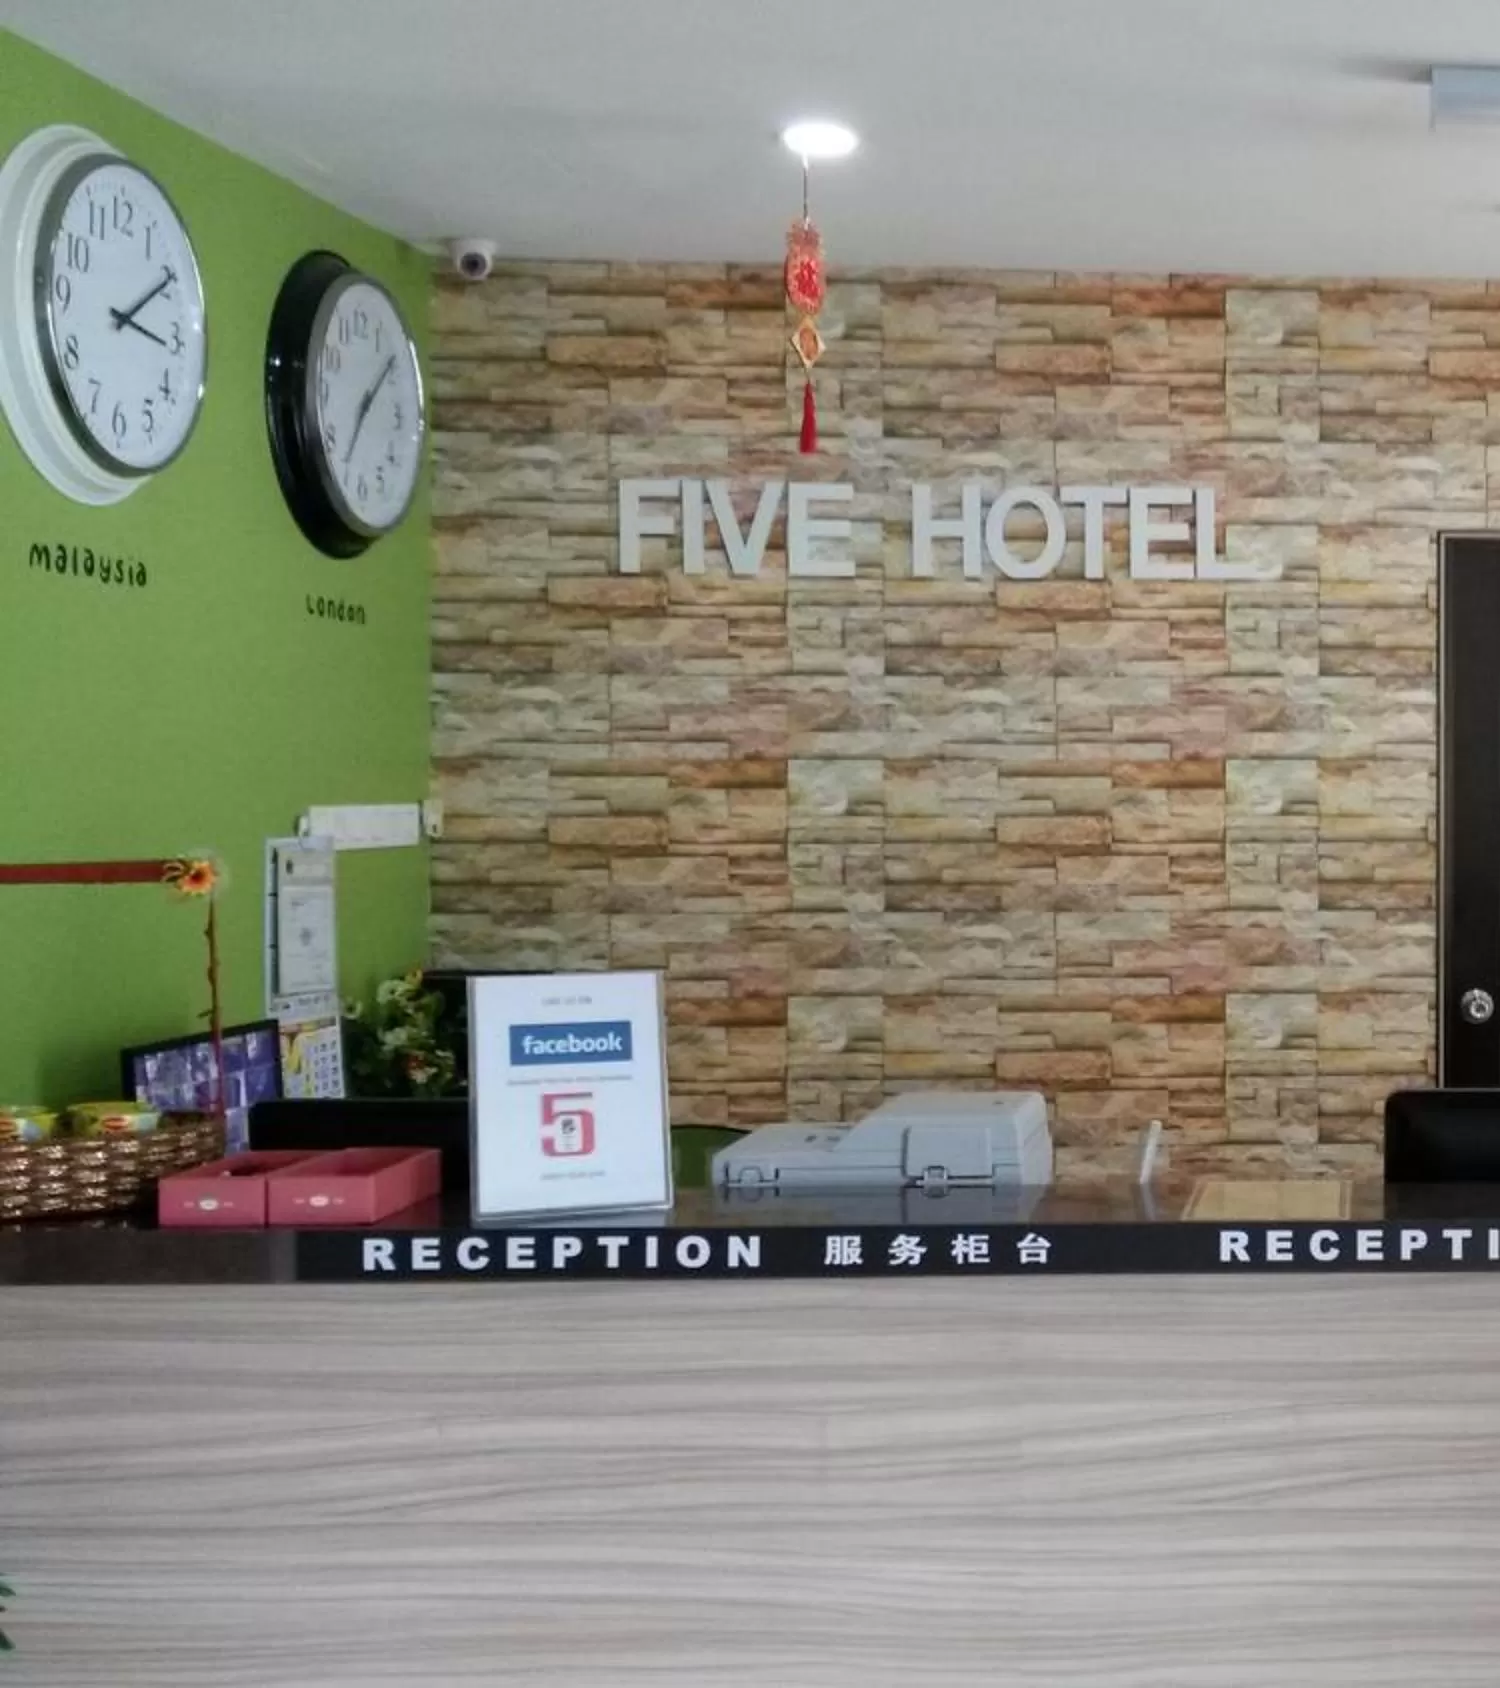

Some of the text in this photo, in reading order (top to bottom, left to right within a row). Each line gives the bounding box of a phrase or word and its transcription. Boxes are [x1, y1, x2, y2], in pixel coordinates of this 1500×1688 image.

[89, 199, 105, 240] 11
[112, 196, 134, 237] 12
[67, 231, 89, 273] 10
[144, 225, 152, 260] 1
[56, 274, 71, 313] 9
[170, 321, 185, 356] 3
[353, 308, 368, 340] 12
[63, 335, 80, 370] 8
[88, 378, 101, 414] 7
[158, 367, 171, 401] 4
[112, 401, 127, 438] 6
[141, 397, 154, 433] 5
[618, 479, 1262, 580] FIVE HOTEL
[521, 1032, 623, 1055] facebook
[541, 1092, 596, 1157] 5
[362, 1234, 763, 1272] RECEPTION
[823, 1233, 1053, 1266] 服务柜台
